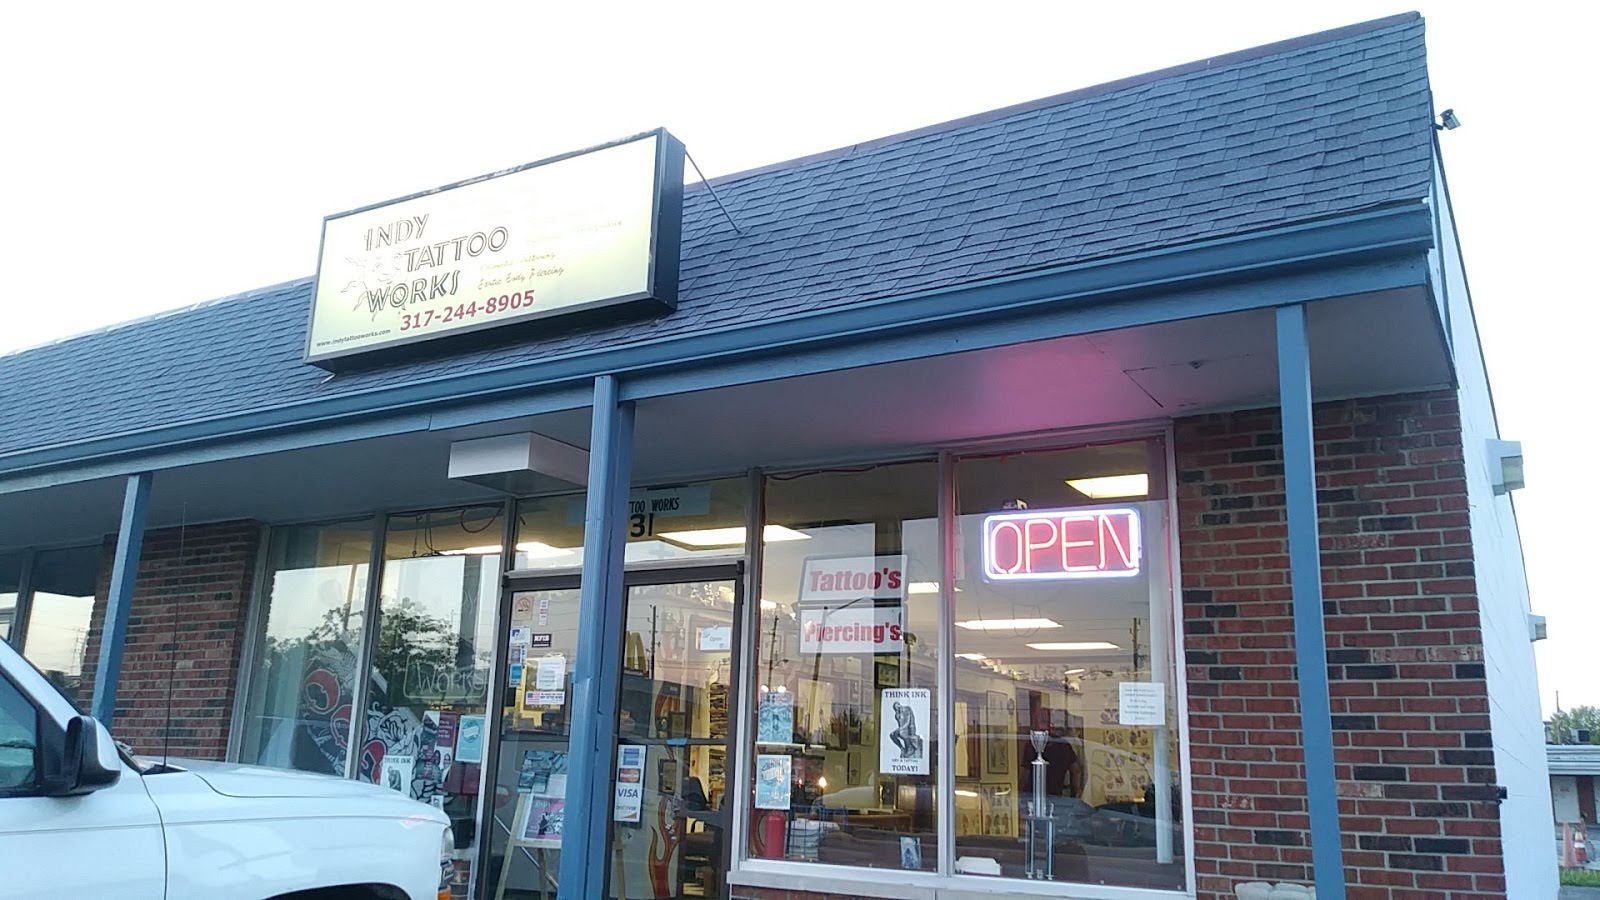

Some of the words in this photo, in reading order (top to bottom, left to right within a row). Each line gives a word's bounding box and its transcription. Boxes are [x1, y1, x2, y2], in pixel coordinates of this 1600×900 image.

[364, 213, 430, 252] INDY
[404, 226, 509, 273] TATTOO
[365, 270, 461, 313] WORKS
[400, 289, 535, 331] 317-244-8905
[316, 328, 391, 347] www.indytattooworks.com
[628, 500, 646, 514] TOO
[652, 497, 680, 512] WORKS
[630, 512, 654, 537] 31
[990, 513, 1140, 574] OPEN
[809, 567, 902, 592] Tattoo's
[804, 621, 902, 644] Piercing's
[416, 662, 484, 694] WORKS
[618, 788, 638, 798] VISA
